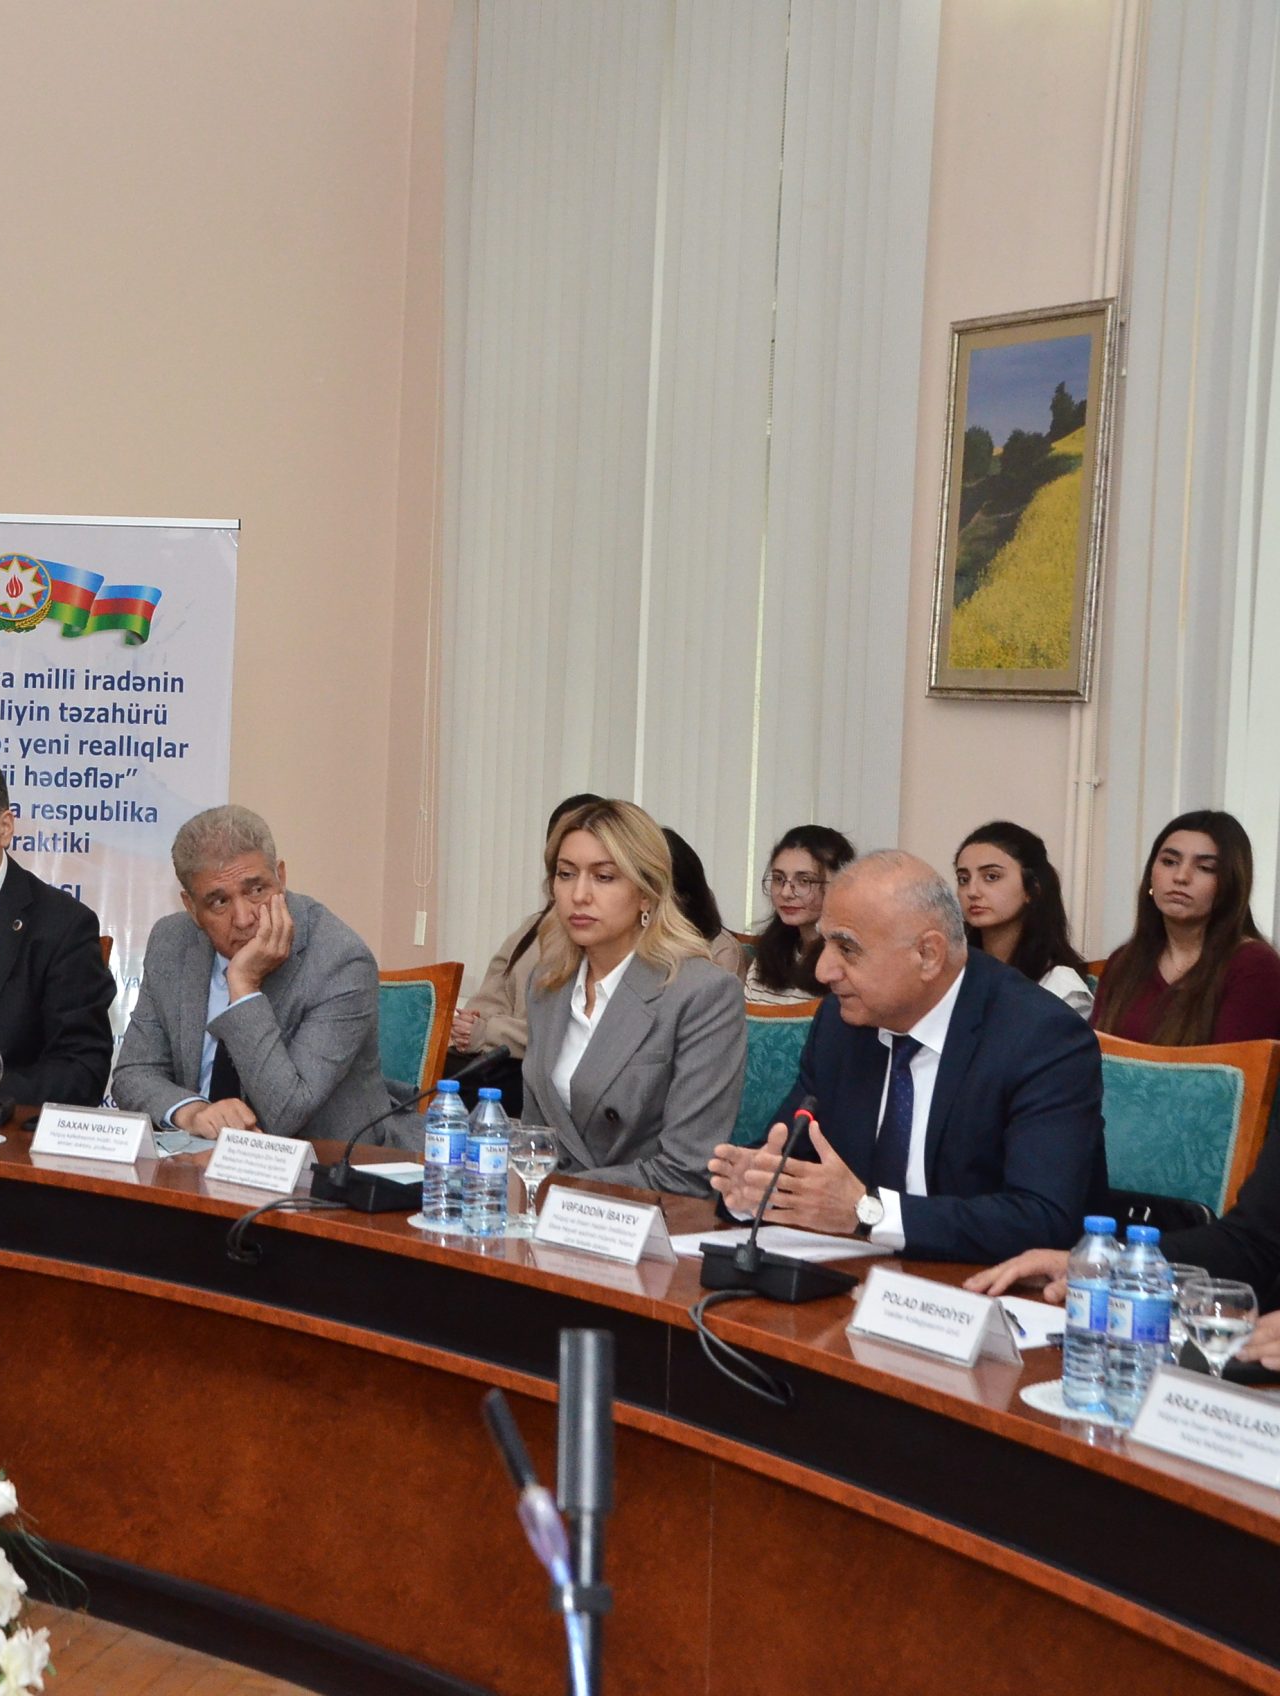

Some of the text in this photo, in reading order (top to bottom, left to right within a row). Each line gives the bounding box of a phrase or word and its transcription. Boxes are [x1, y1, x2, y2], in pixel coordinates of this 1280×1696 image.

[23, 668, 75, 690] milli
[84, 669, 184, 693] iradənin
[58, 702, 168, 725] təzahürü
[19, 733, 70, 758] yeni
[78, 736, 189, 762] reallıqlar
[31, 799, 158, 825] respublika
[882, 1291, 918, 1309] POLAD
